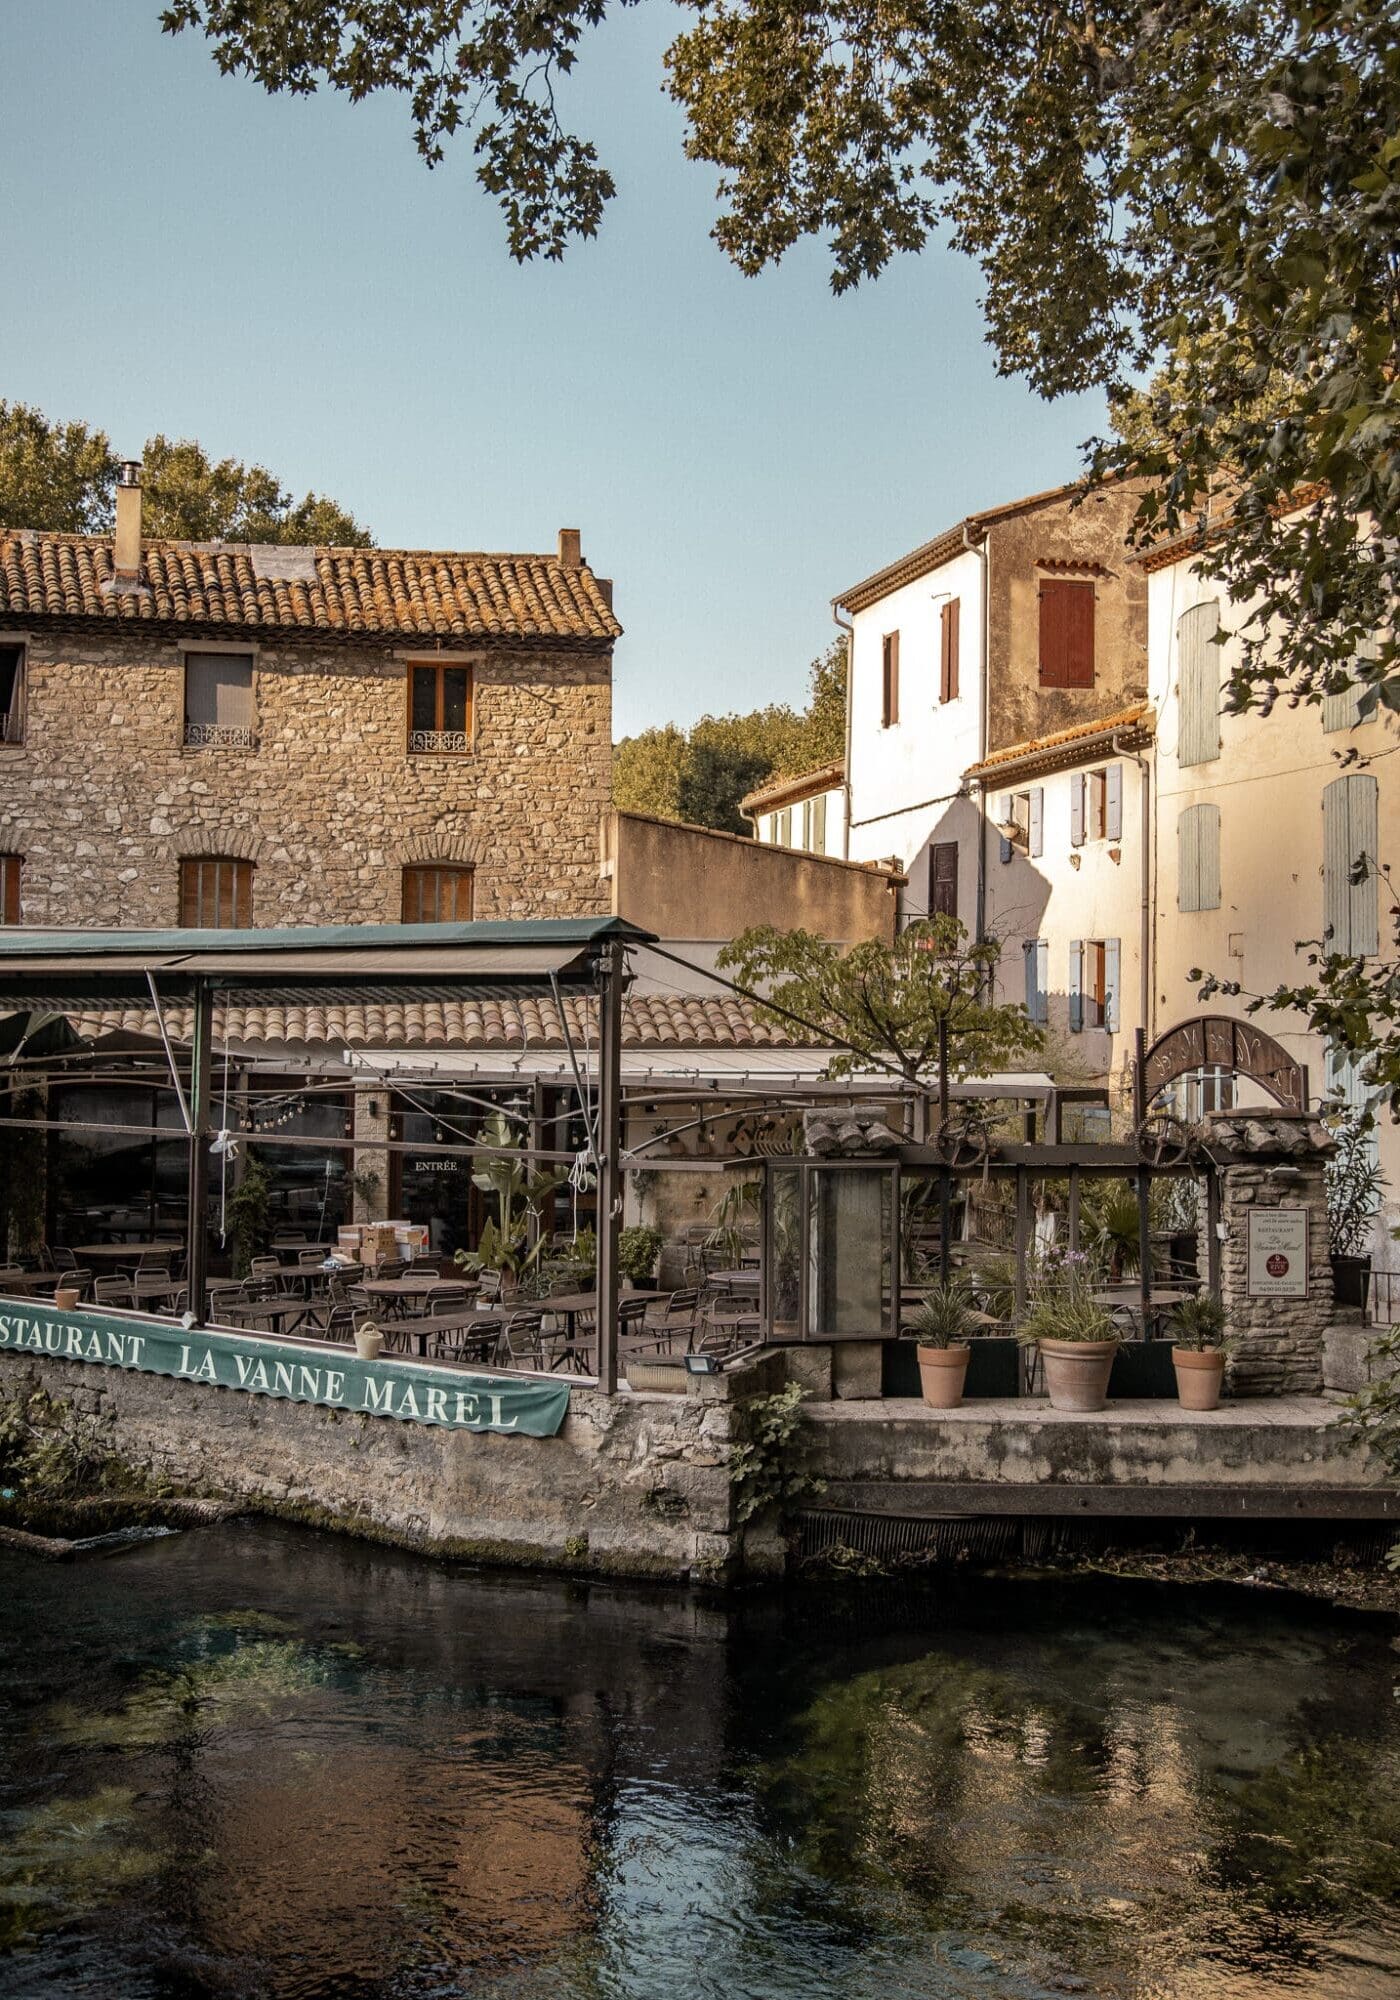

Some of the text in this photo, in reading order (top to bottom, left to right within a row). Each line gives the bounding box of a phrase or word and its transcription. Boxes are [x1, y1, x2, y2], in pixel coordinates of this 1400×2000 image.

[415, 1160, 458, 1171] ENTRÉE
[178, 1345, 217, 1380] LA
[233, 1354, 345, 1402] VANNE
[361, 1376, 519, 1427] MAREL
